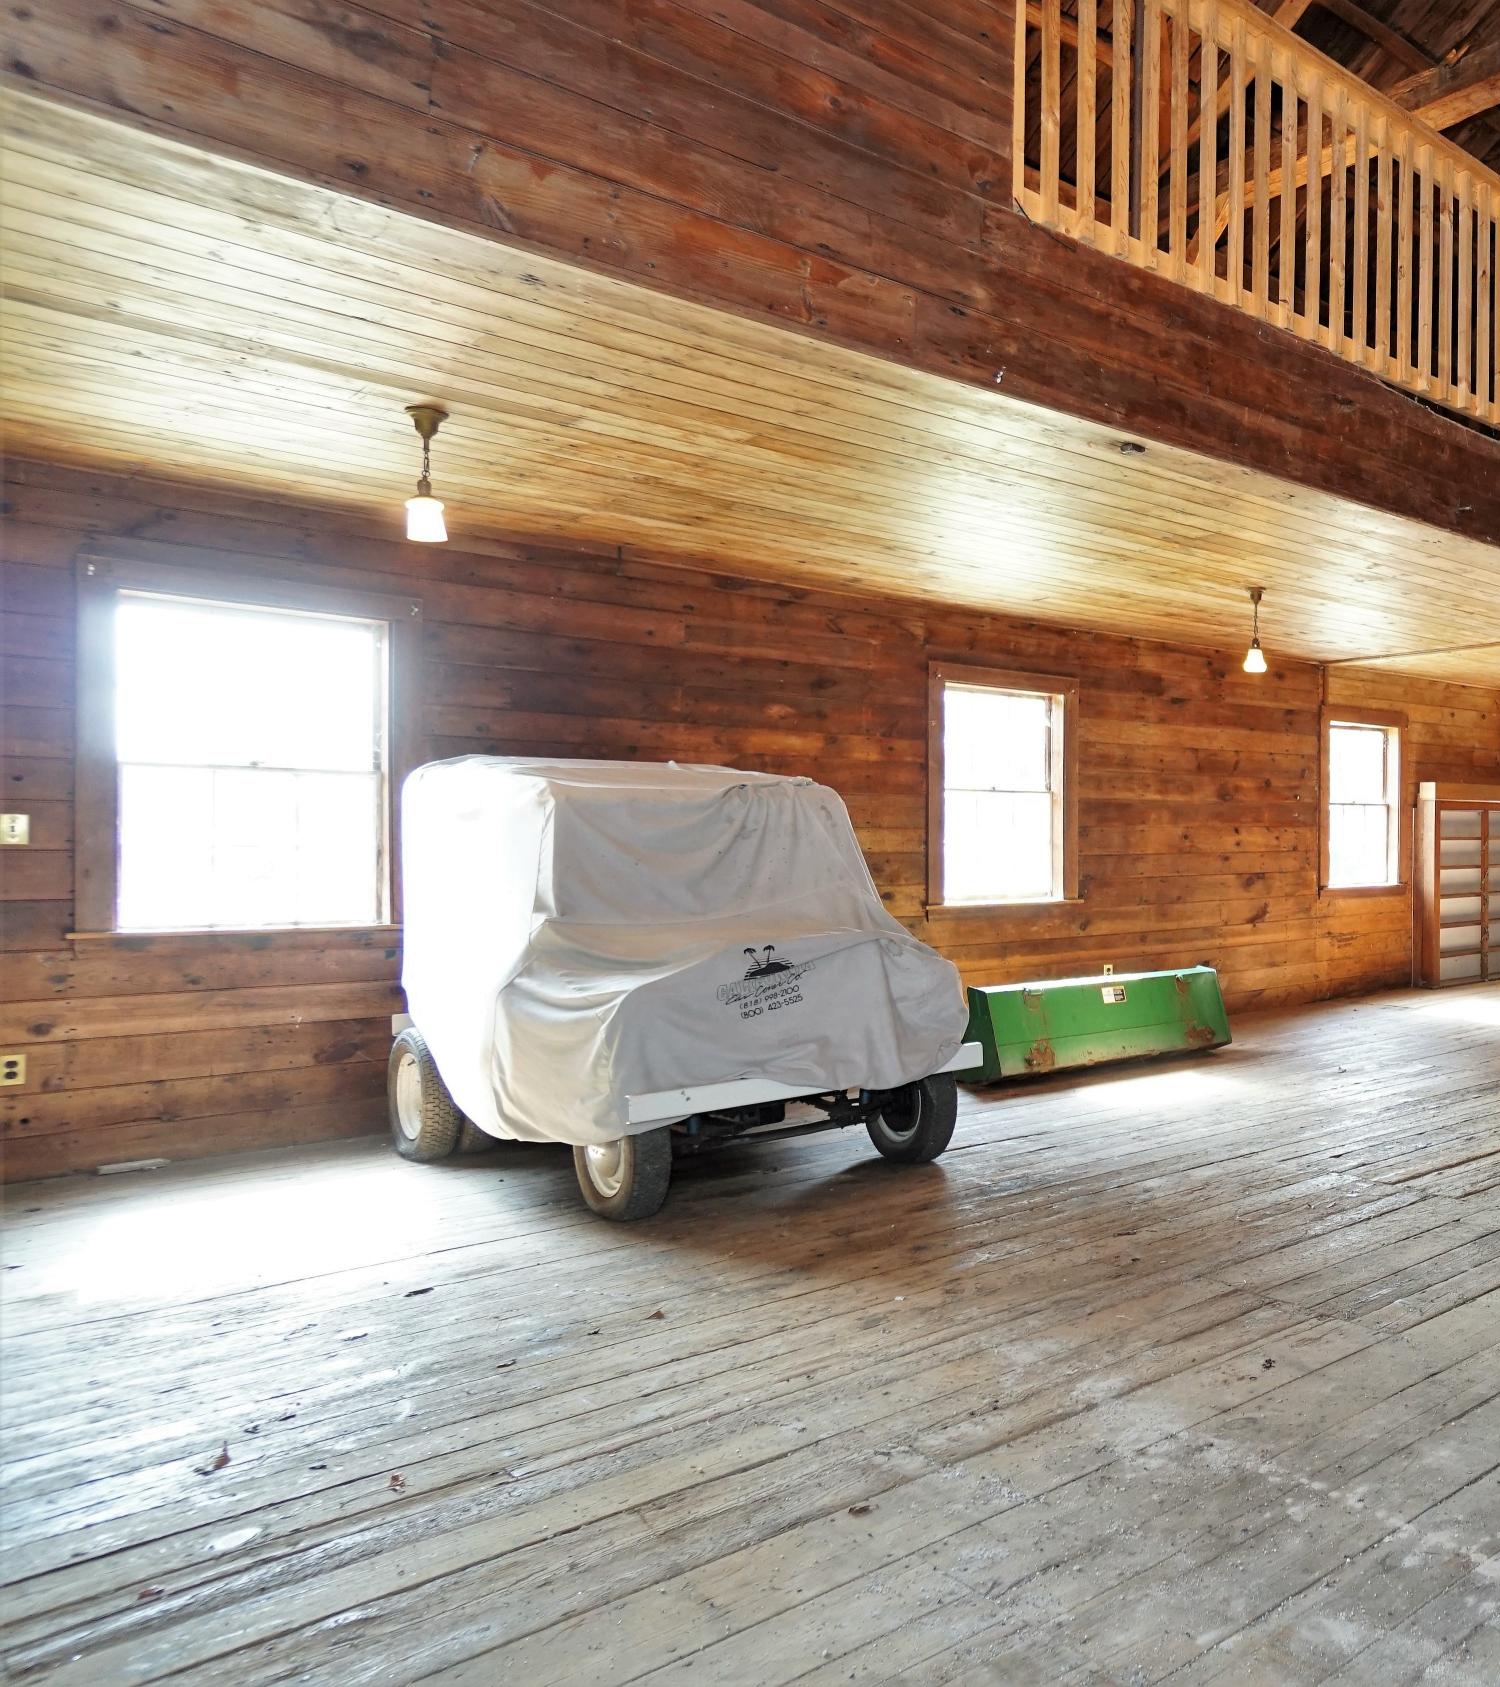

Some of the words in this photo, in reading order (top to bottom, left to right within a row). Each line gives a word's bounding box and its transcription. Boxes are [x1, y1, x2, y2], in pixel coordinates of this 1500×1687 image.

[764, 984, 800, 1003] 998-2100
[740, 1007, 764, 1020] (800)
[767, 993, 804, 1012] 423-5525
